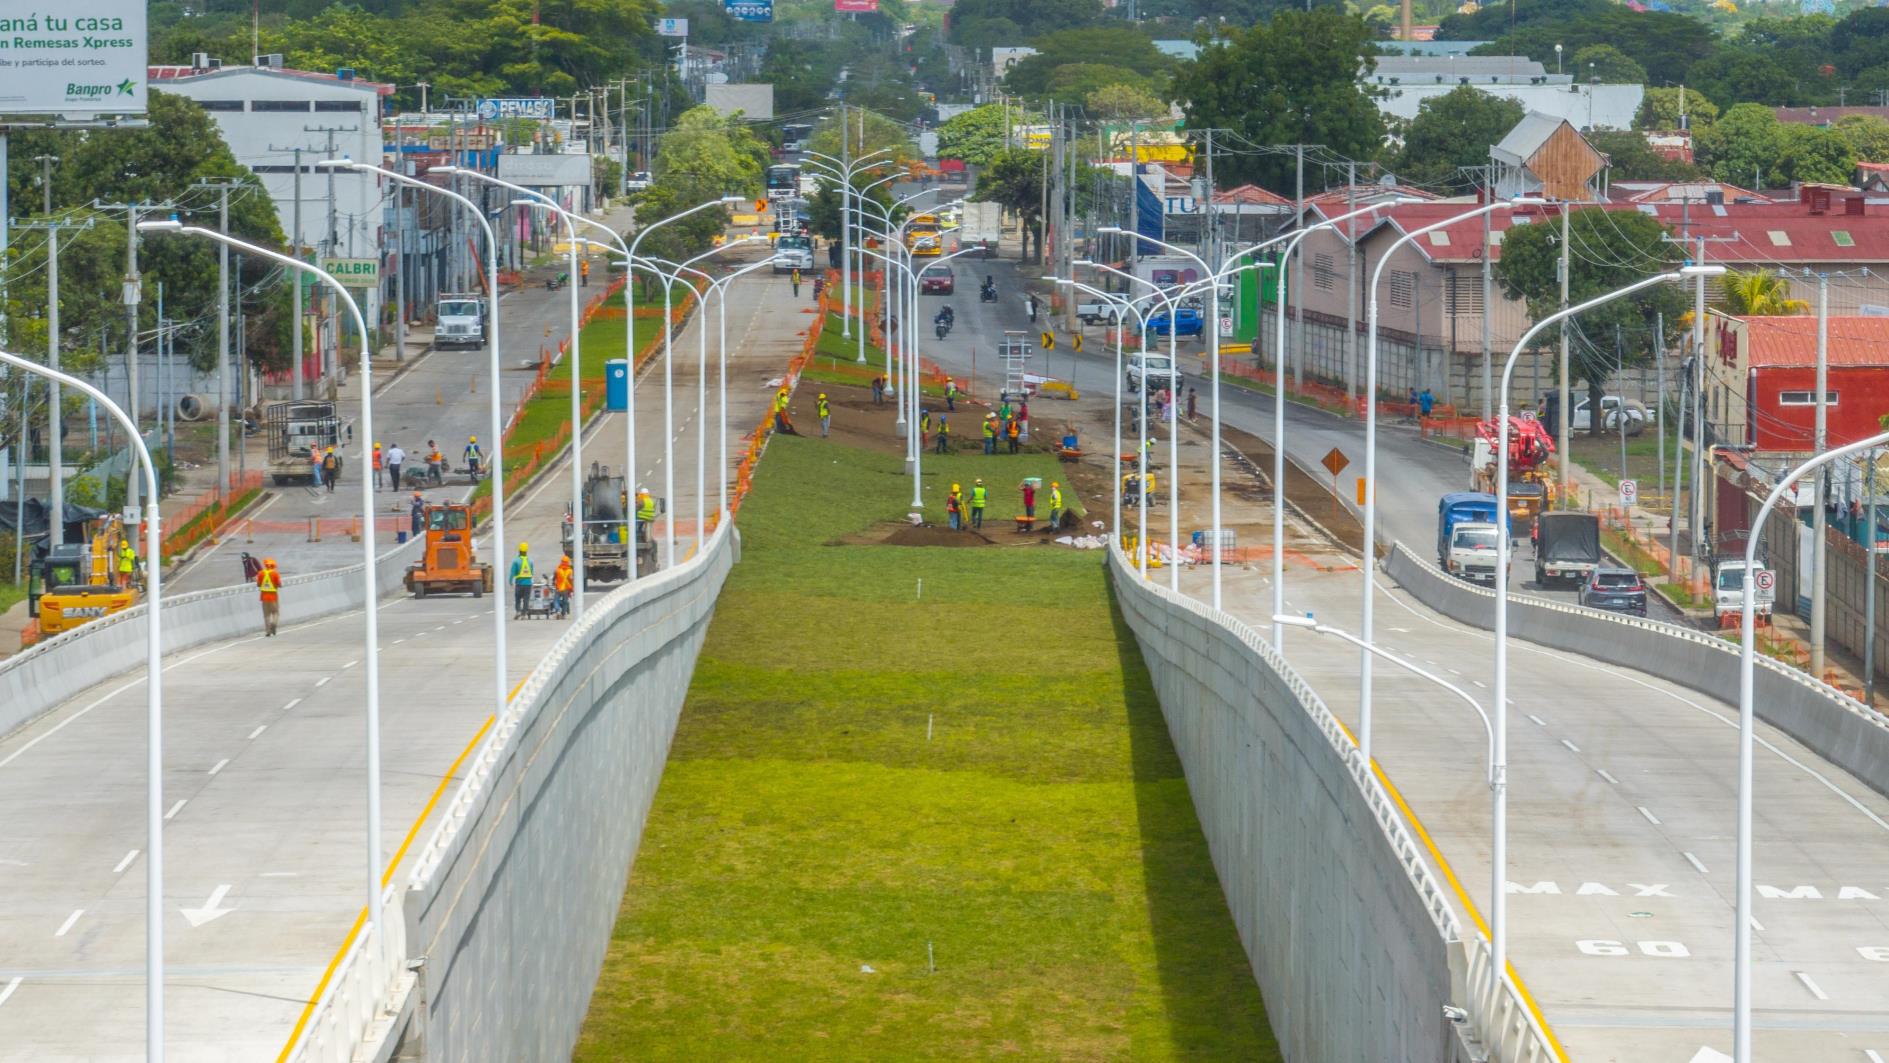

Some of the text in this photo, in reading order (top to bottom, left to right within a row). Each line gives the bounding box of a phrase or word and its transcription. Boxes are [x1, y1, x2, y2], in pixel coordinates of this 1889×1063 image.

[45, 15, 67, 31] tu
[75, 18, 123, 31] casa
[14, 37, 79, 48] Remesas
[83, 36, 133, 50] Xpress
[22, 58, 59, 68] participa
[61, 58, 75, 66] del
[66, 83, 112, 97] Banpro
[326, 263, 376, 275] CALBRI
[63, 607, 107, 618] SANY
[1505, 880, 1678, 897] MAX
[1755, 885, 1889, 900] MA
[1576, 940, 1691, 958] 60
